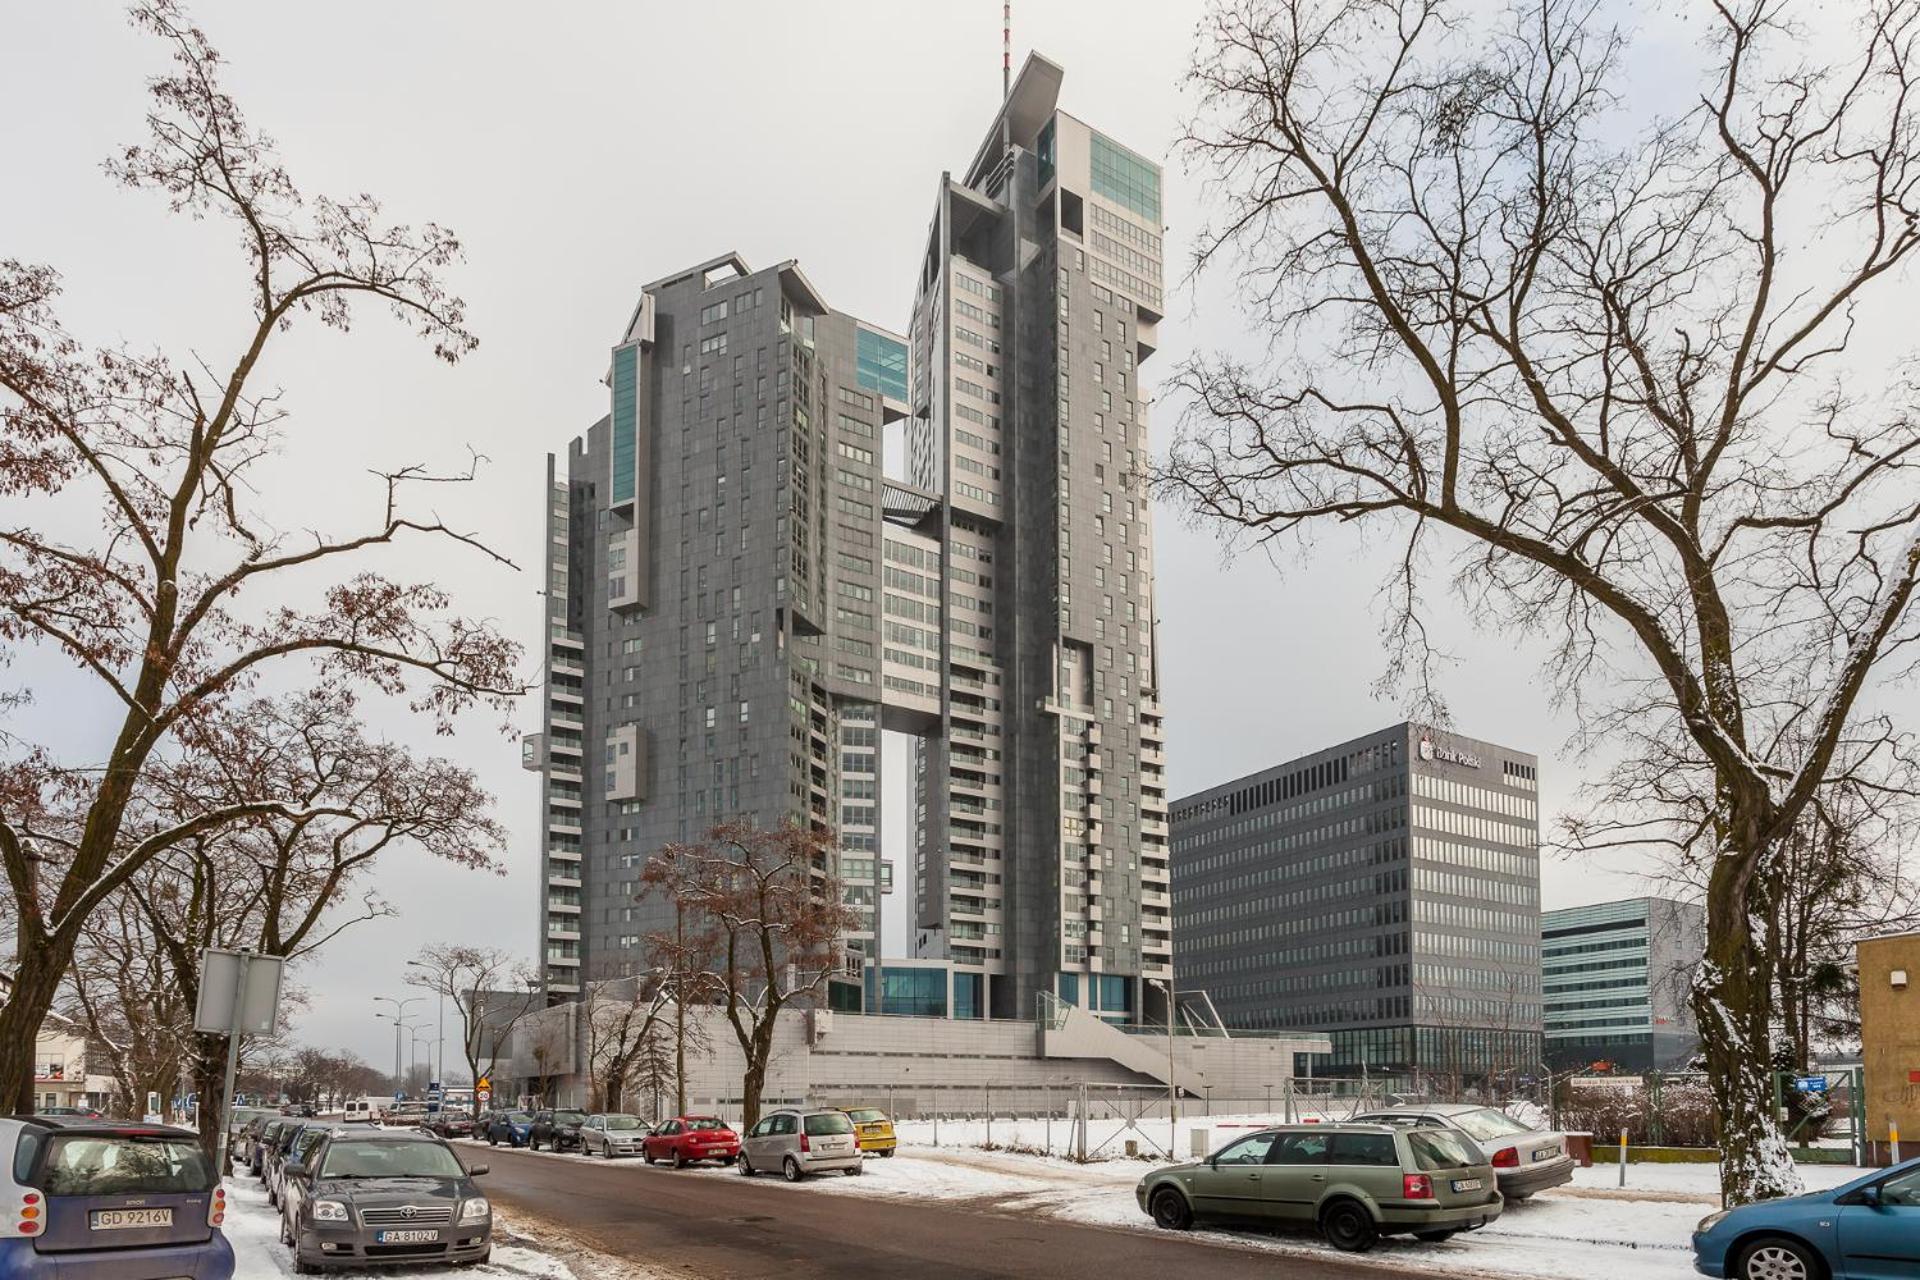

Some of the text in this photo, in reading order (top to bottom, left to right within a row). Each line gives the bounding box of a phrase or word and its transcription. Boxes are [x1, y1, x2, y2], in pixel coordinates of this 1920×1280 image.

[101, 1210, 170, 1225] GD 9216V
[386, 1231, 437, 1242] GA 8102V
